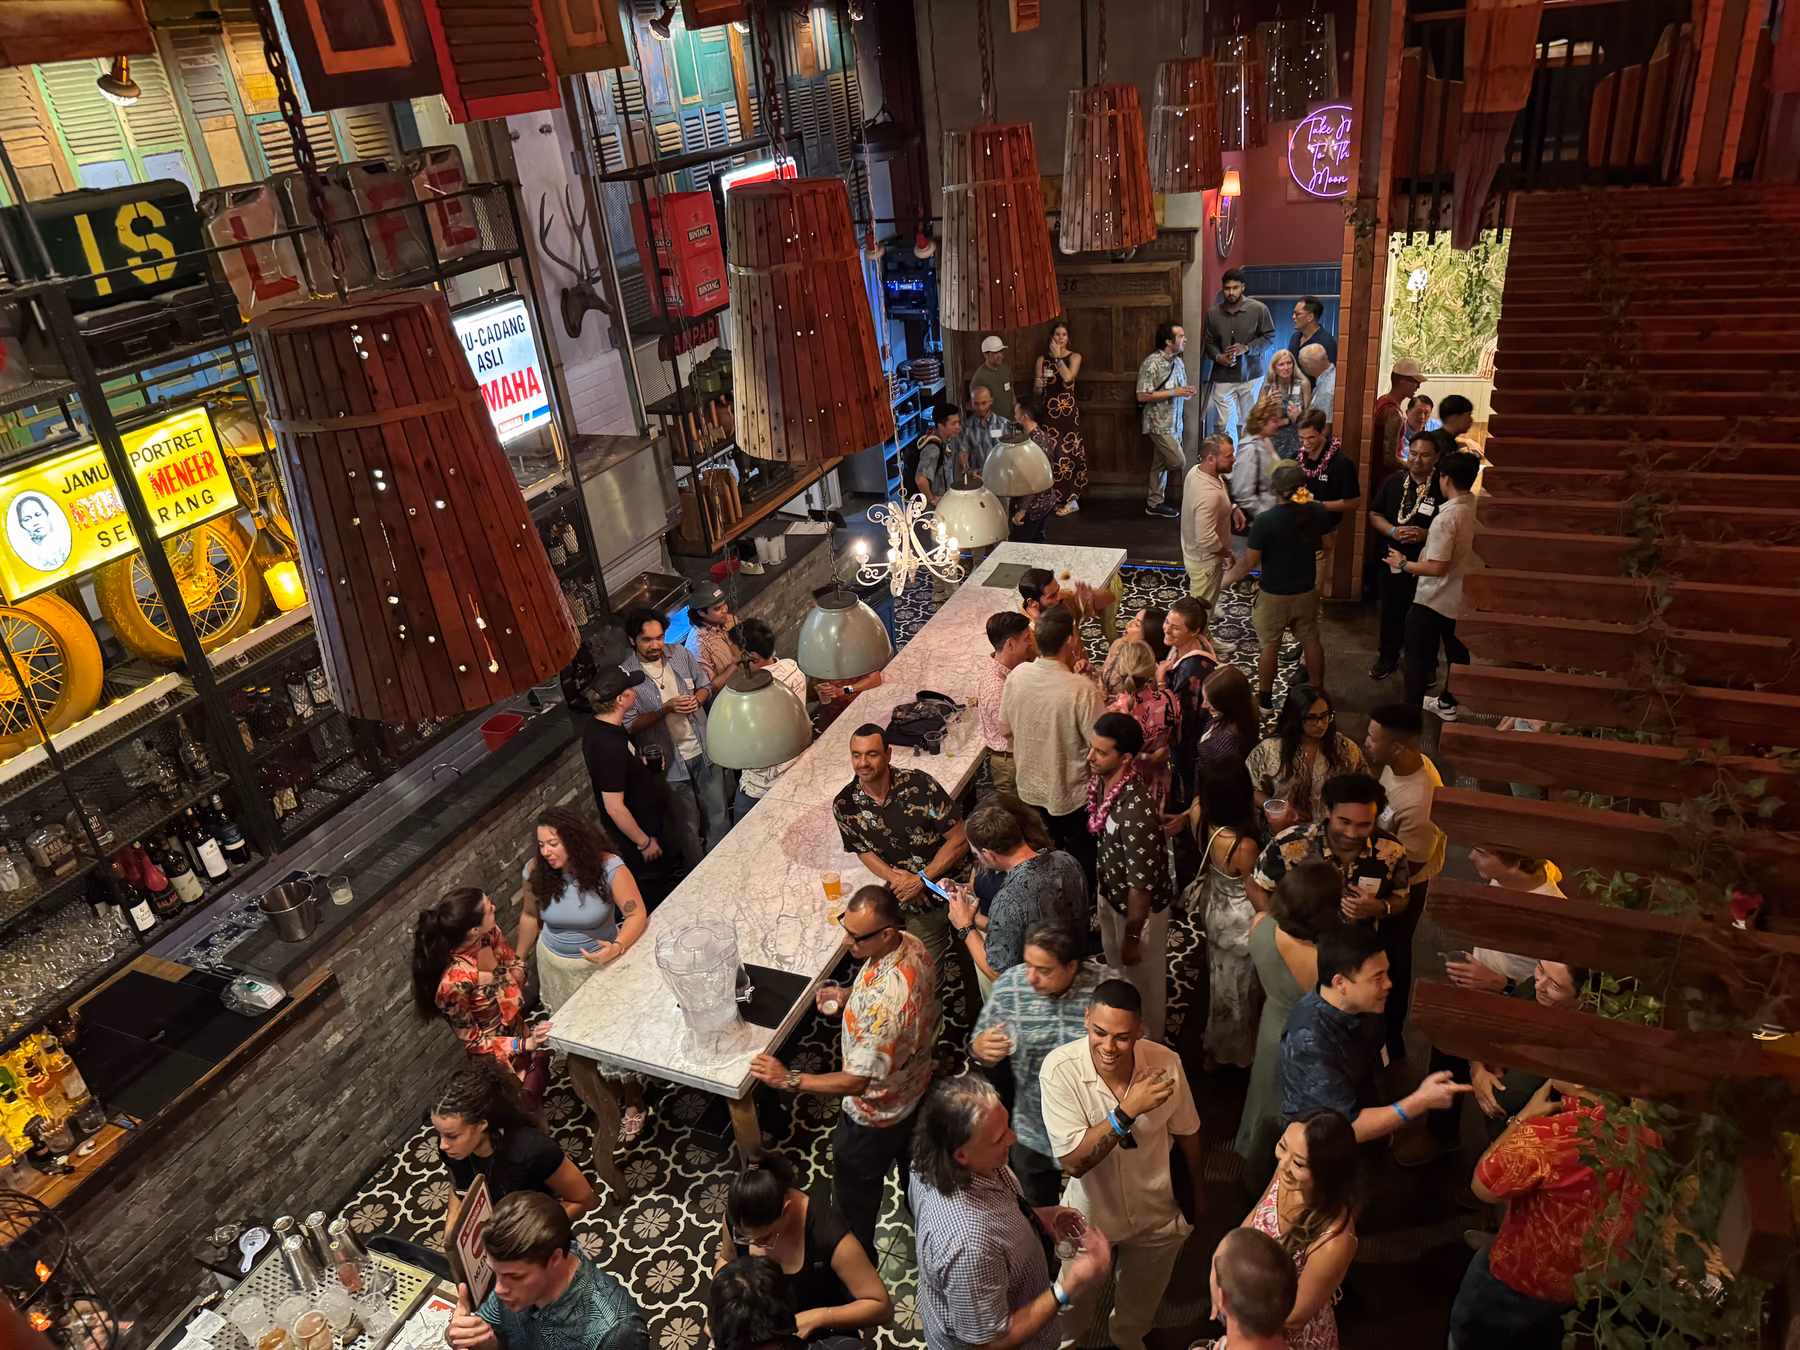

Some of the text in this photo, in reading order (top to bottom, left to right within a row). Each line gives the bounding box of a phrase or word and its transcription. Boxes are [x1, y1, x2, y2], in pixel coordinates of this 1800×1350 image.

[1303, 115, 1334, 142] Take
[1308, 141, 1350, 168] To Th
[1309, 167, 1348, 193] Moon
[229, 168, 477, 301] LFE
[688, 226, 710, 241] BINTANG
[698, 280, 720, 295] BINTANG
[460, 315, 526, 351] U-CADANG
[477, 347, 504, 373] ASLI
[480, 366, 542, 413] MAHA
[62, 428, 205, 495] JAMU PORTRET
[69, 450, 219, 531] NYON MENEER
[474, 1265, 481, 1283] NO
